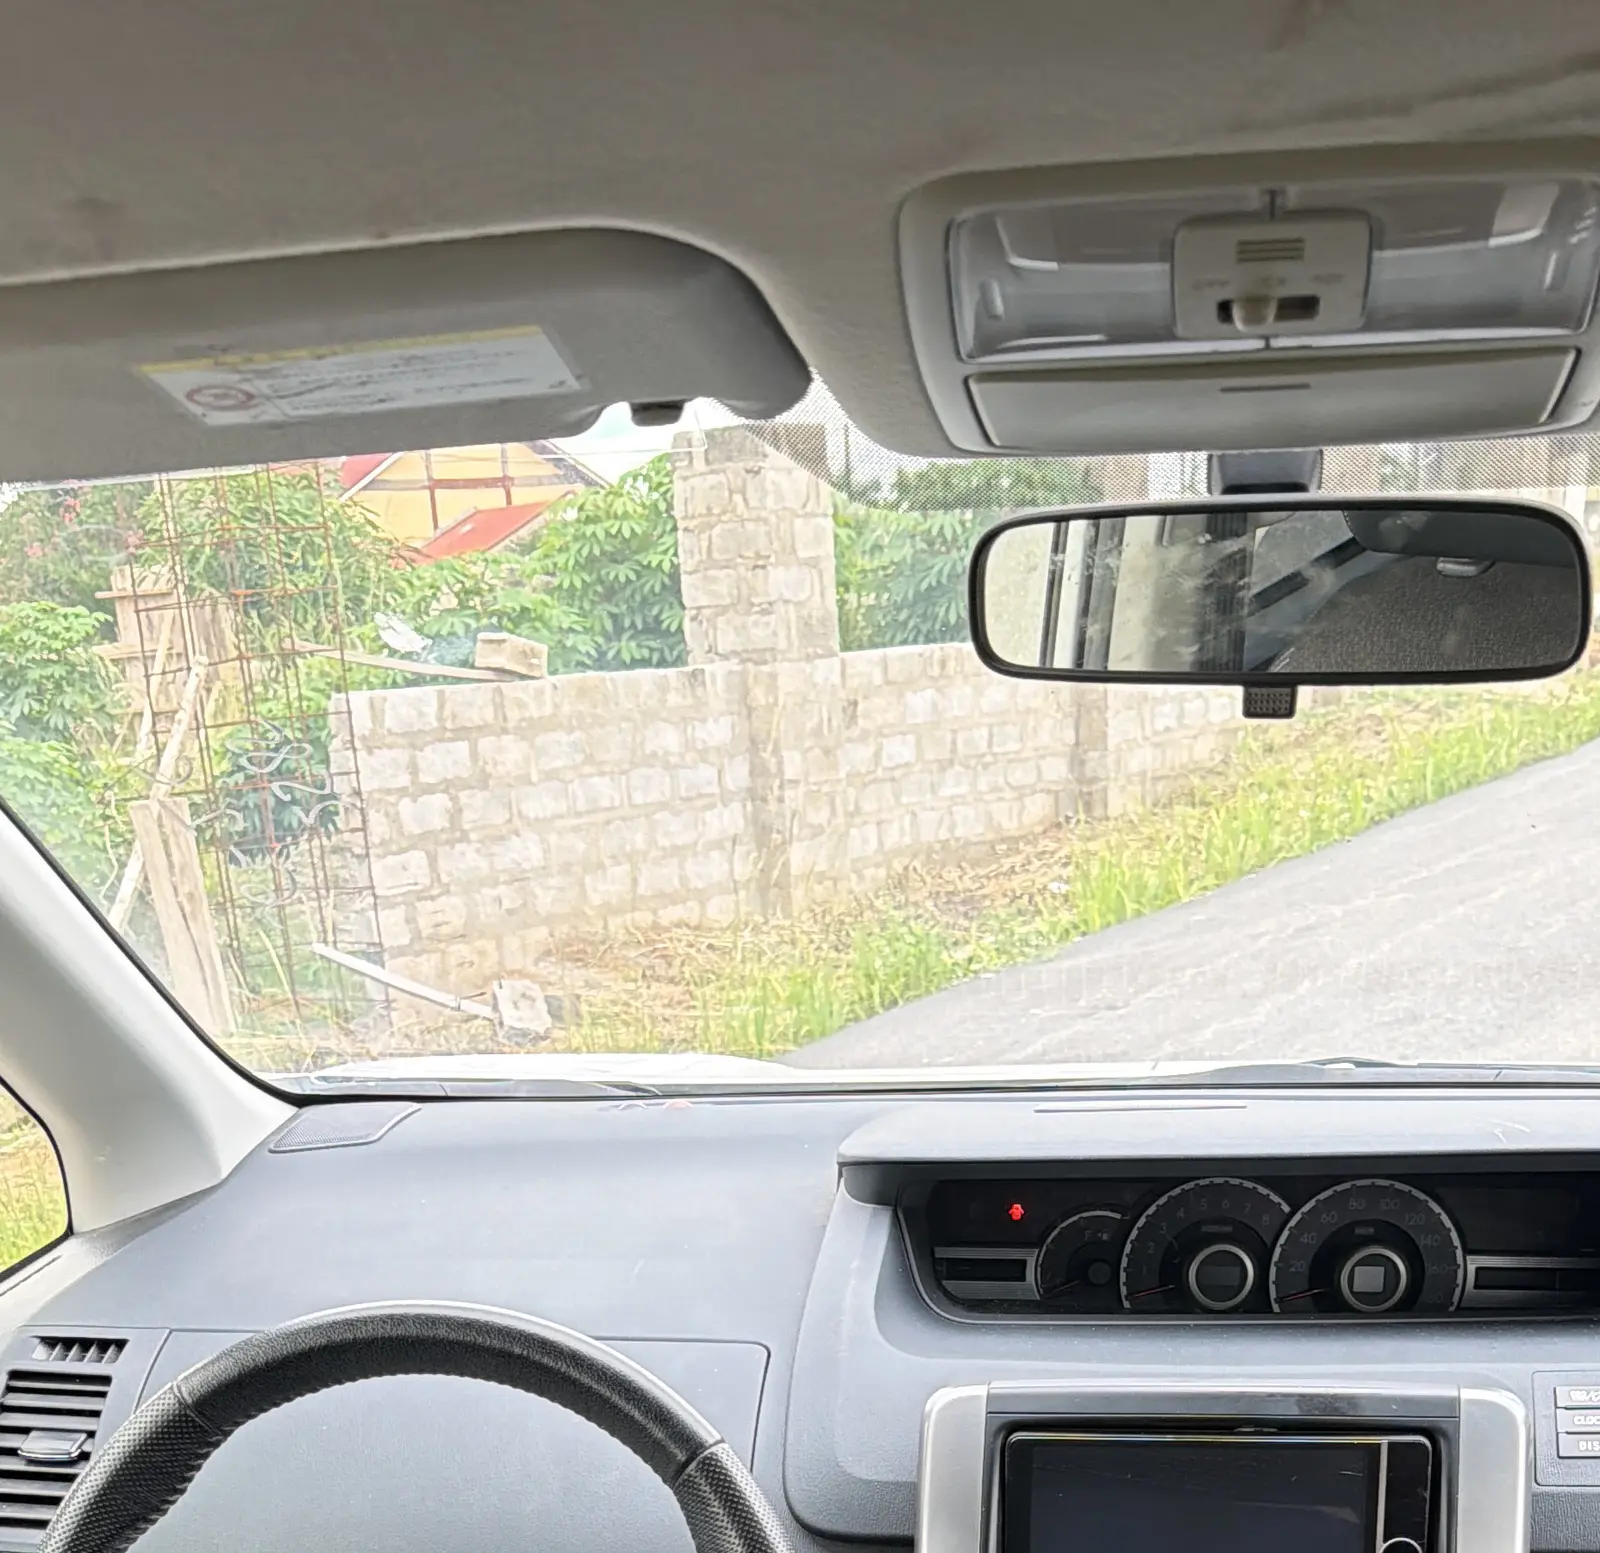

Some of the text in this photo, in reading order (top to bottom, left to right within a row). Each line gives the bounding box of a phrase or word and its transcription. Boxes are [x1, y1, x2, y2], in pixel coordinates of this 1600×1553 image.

[1349, 1199, 1366, 1210] 80
[1320, 1212, 1338, 1223] 60
[1404, 1213, 1425, 1225] 120
[1300, 1232, 1317, 1244] 40
[1420, 1234, 1441, 1246] 140
[1289, 1260, 1306, 1272] 20
